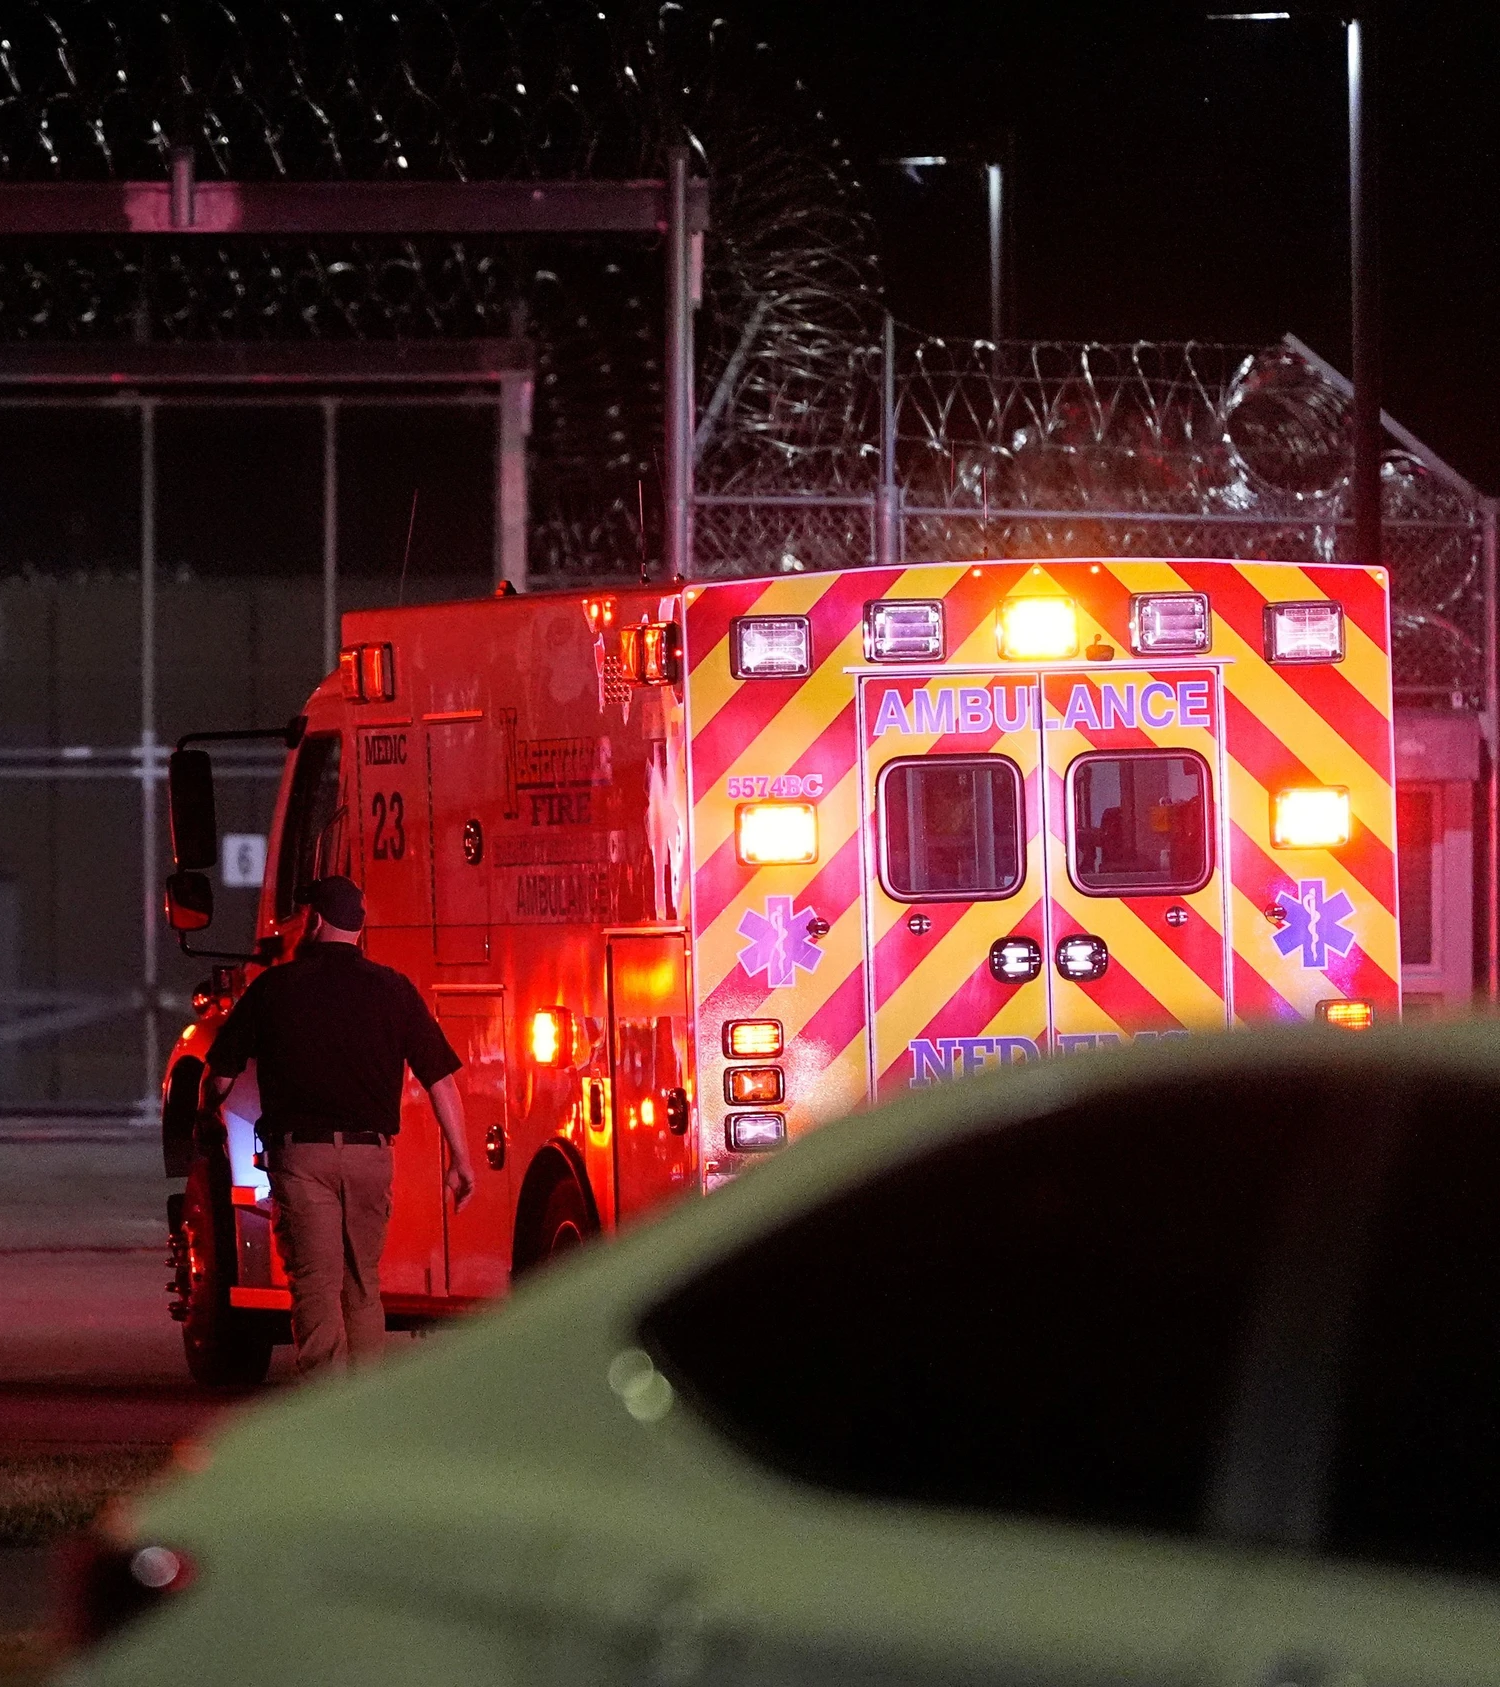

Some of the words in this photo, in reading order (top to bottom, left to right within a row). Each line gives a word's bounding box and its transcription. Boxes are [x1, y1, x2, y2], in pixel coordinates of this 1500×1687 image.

[873, 680, 1211, 736] AMBULANCE
[364, 734, 407, 765] MEDIC
[726, 774, 823, 799] 5574BC
[372, 792, 405, 860] 23
[530, 791, 593, 826] FIRE
